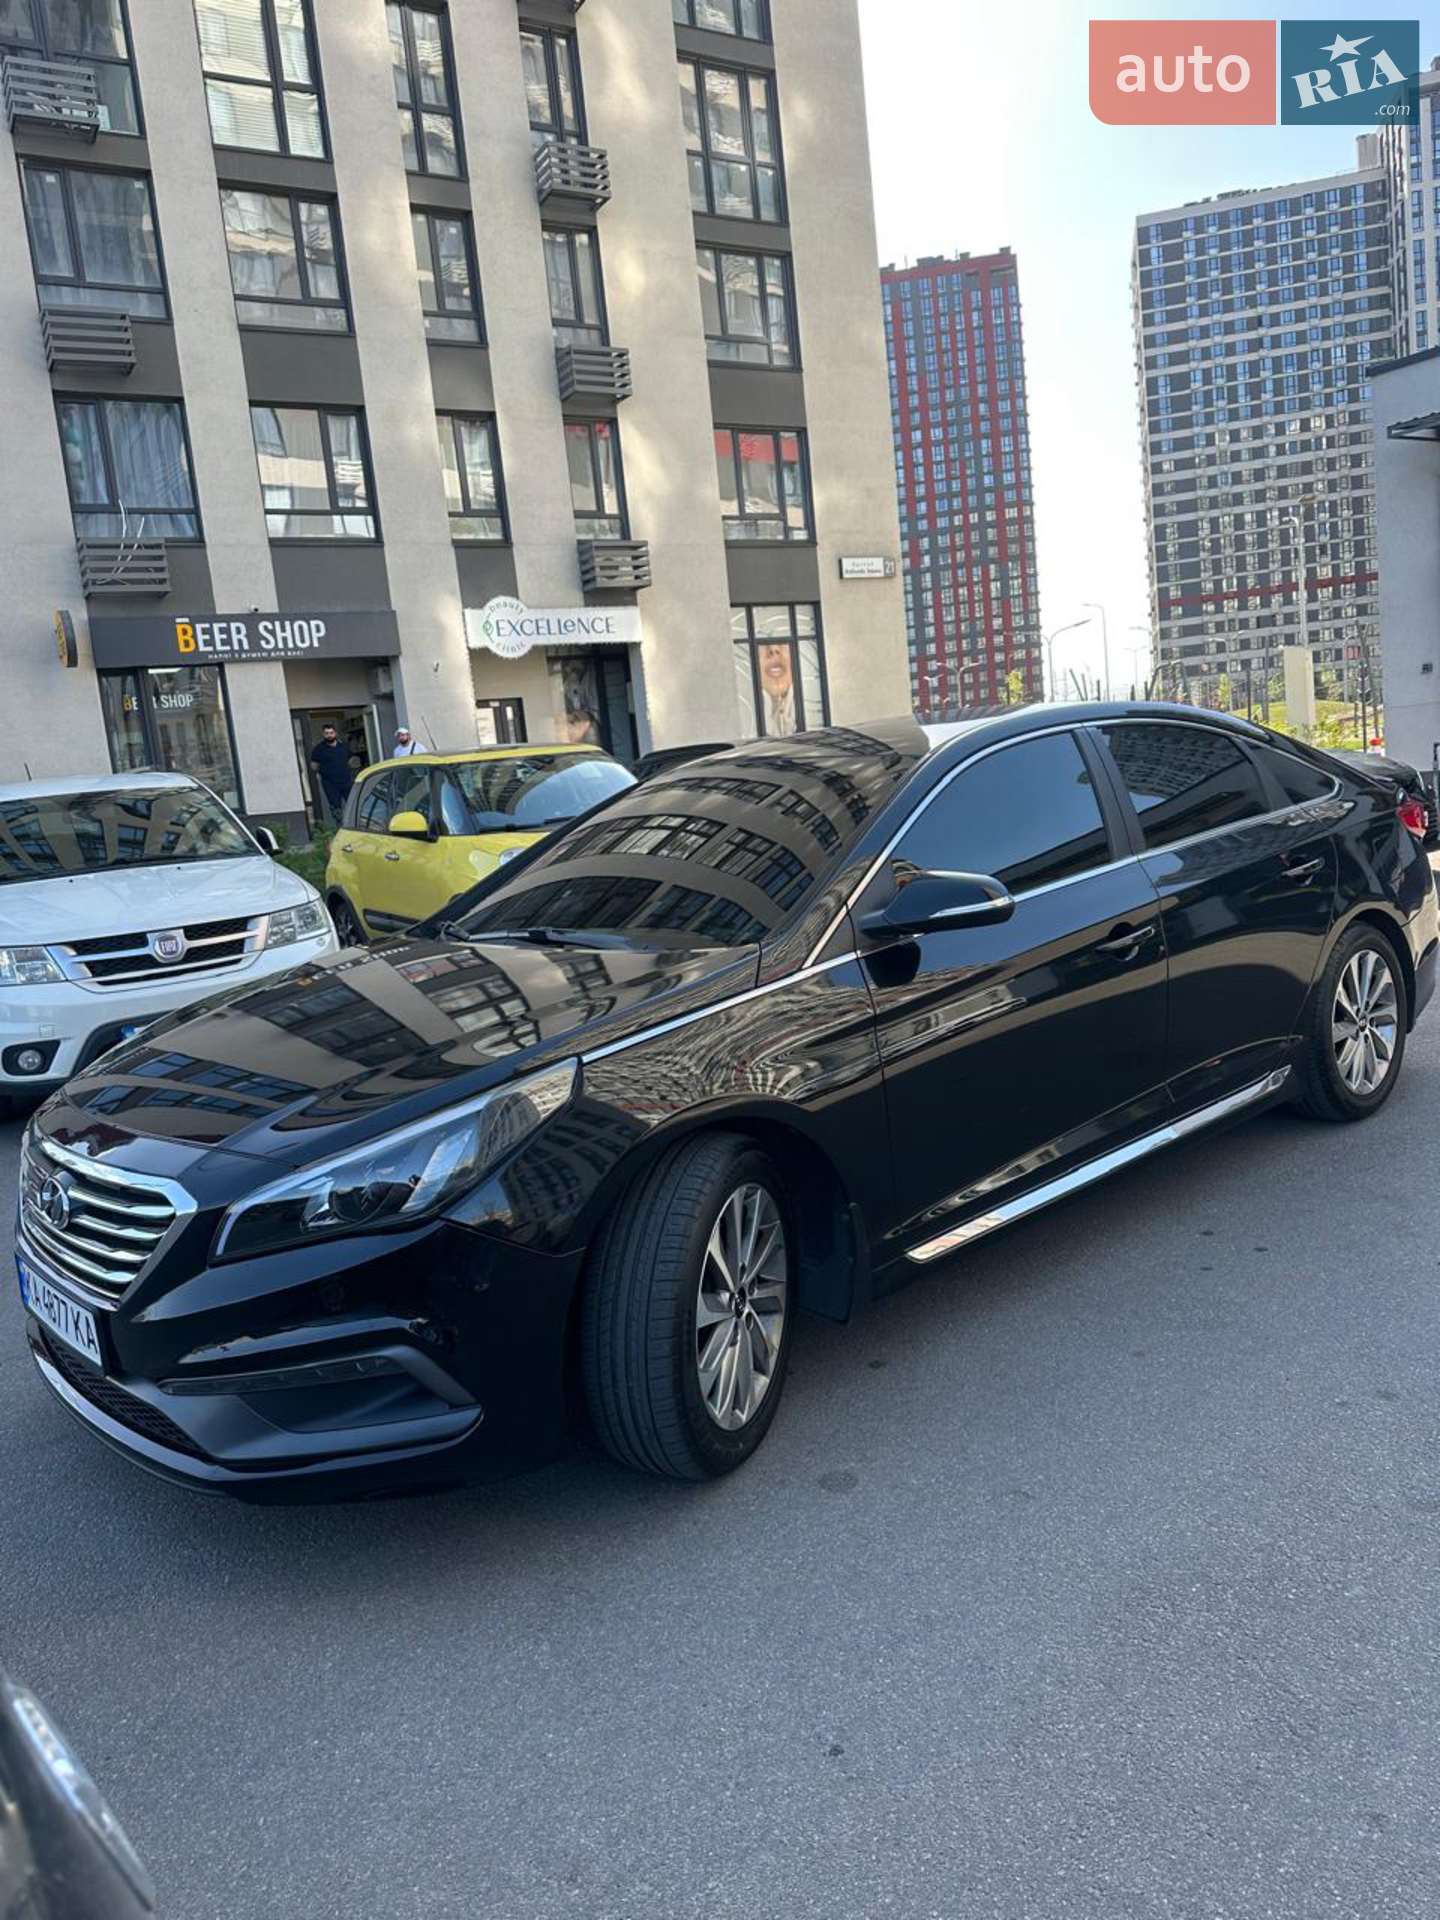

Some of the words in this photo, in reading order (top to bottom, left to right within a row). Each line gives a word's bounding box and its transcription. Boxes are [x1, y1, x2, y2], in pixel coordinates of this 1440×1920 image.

[489, 601, 524, 615] beauty
[175, 619, 250, 652] BEER
[258, 620, 326, 649] SHOP
[496, 642, 526, 654] clinic
[160, 694, 193, 709] SHOP
